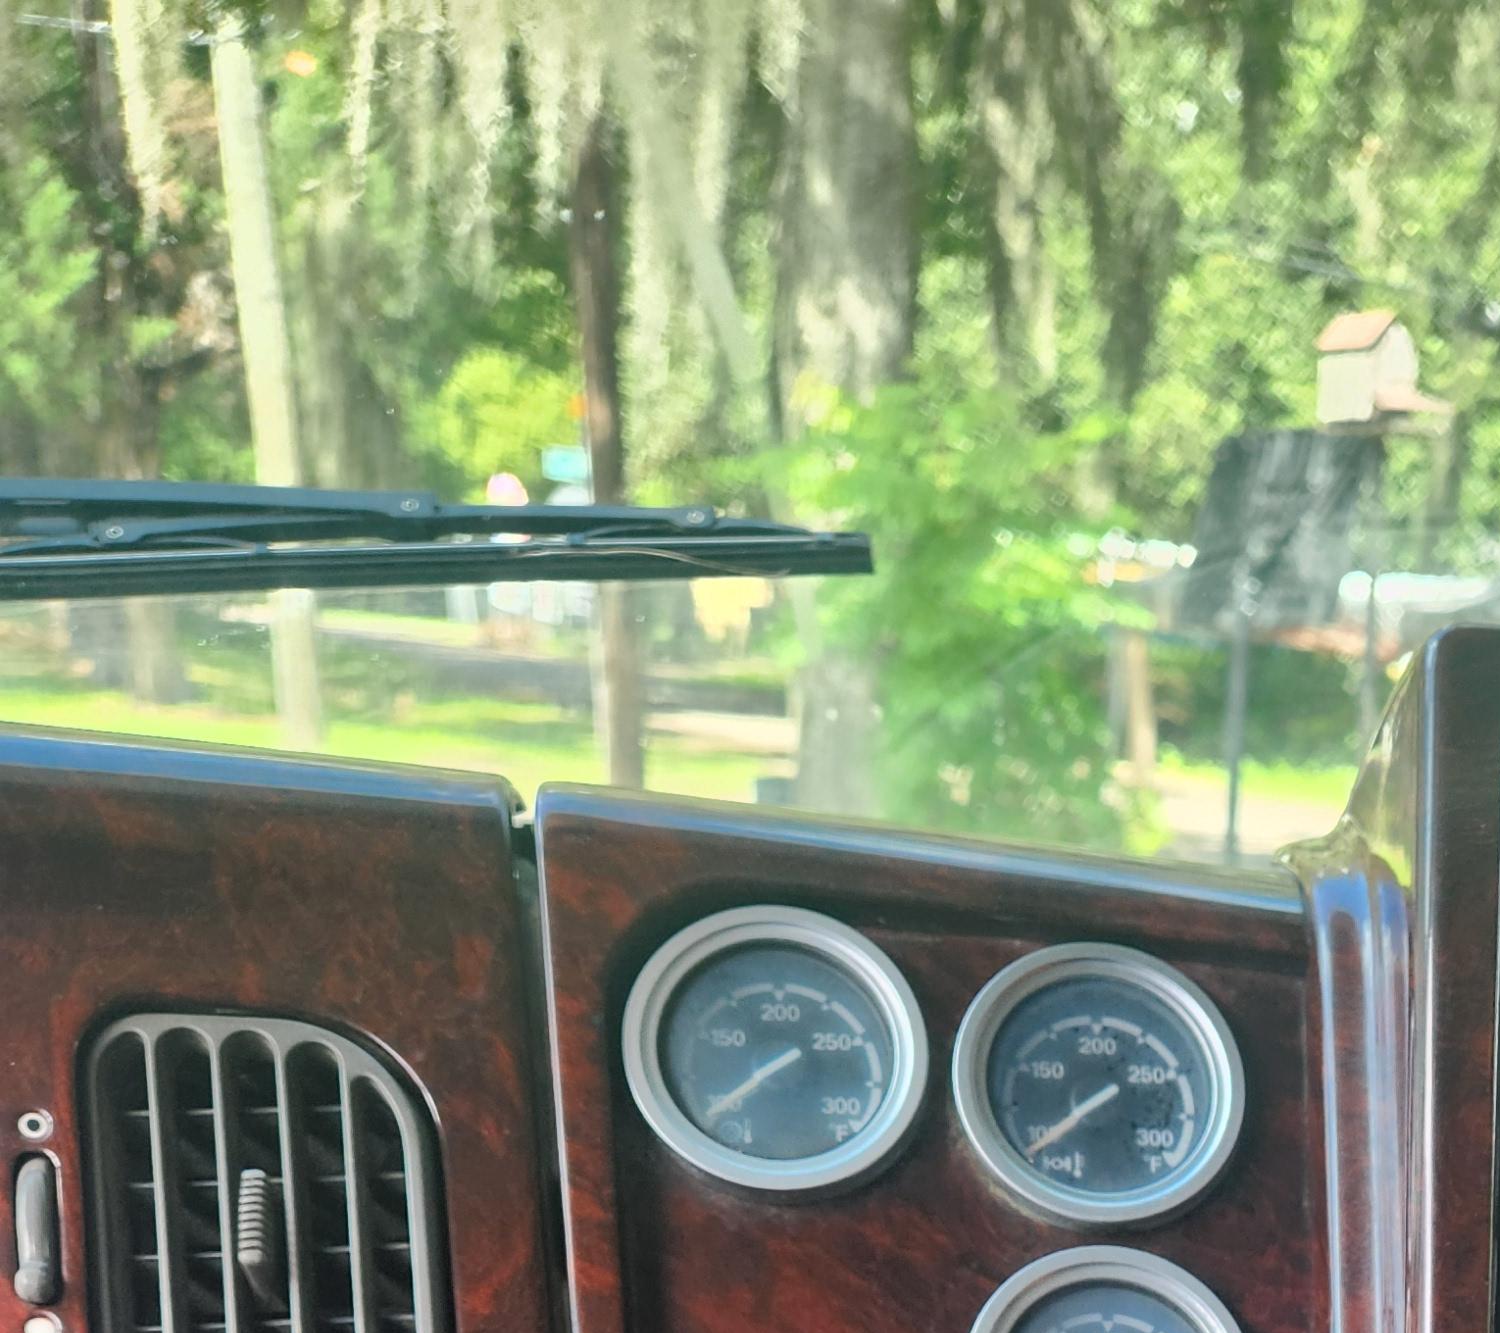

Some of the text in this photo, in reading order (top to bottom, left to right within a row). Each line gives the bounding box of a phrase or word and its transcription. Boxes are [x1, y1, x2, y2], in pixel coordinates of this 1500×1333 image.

[760, 1003, 800, 1022] 200
[711, 1028, 746, 1047] 150
[811, 1032, 852, 1051] 250
[1077, 1036, 1117, 1055] 200
[1030, 1061, 1065, 1079] 150
[1127, 1065, 1166, 1084] 250
[821, 1096, 861, 1115] 300
[1028, 1125, 1055, 1142] 10
[1135, 1128, 1174, 1147] 300
